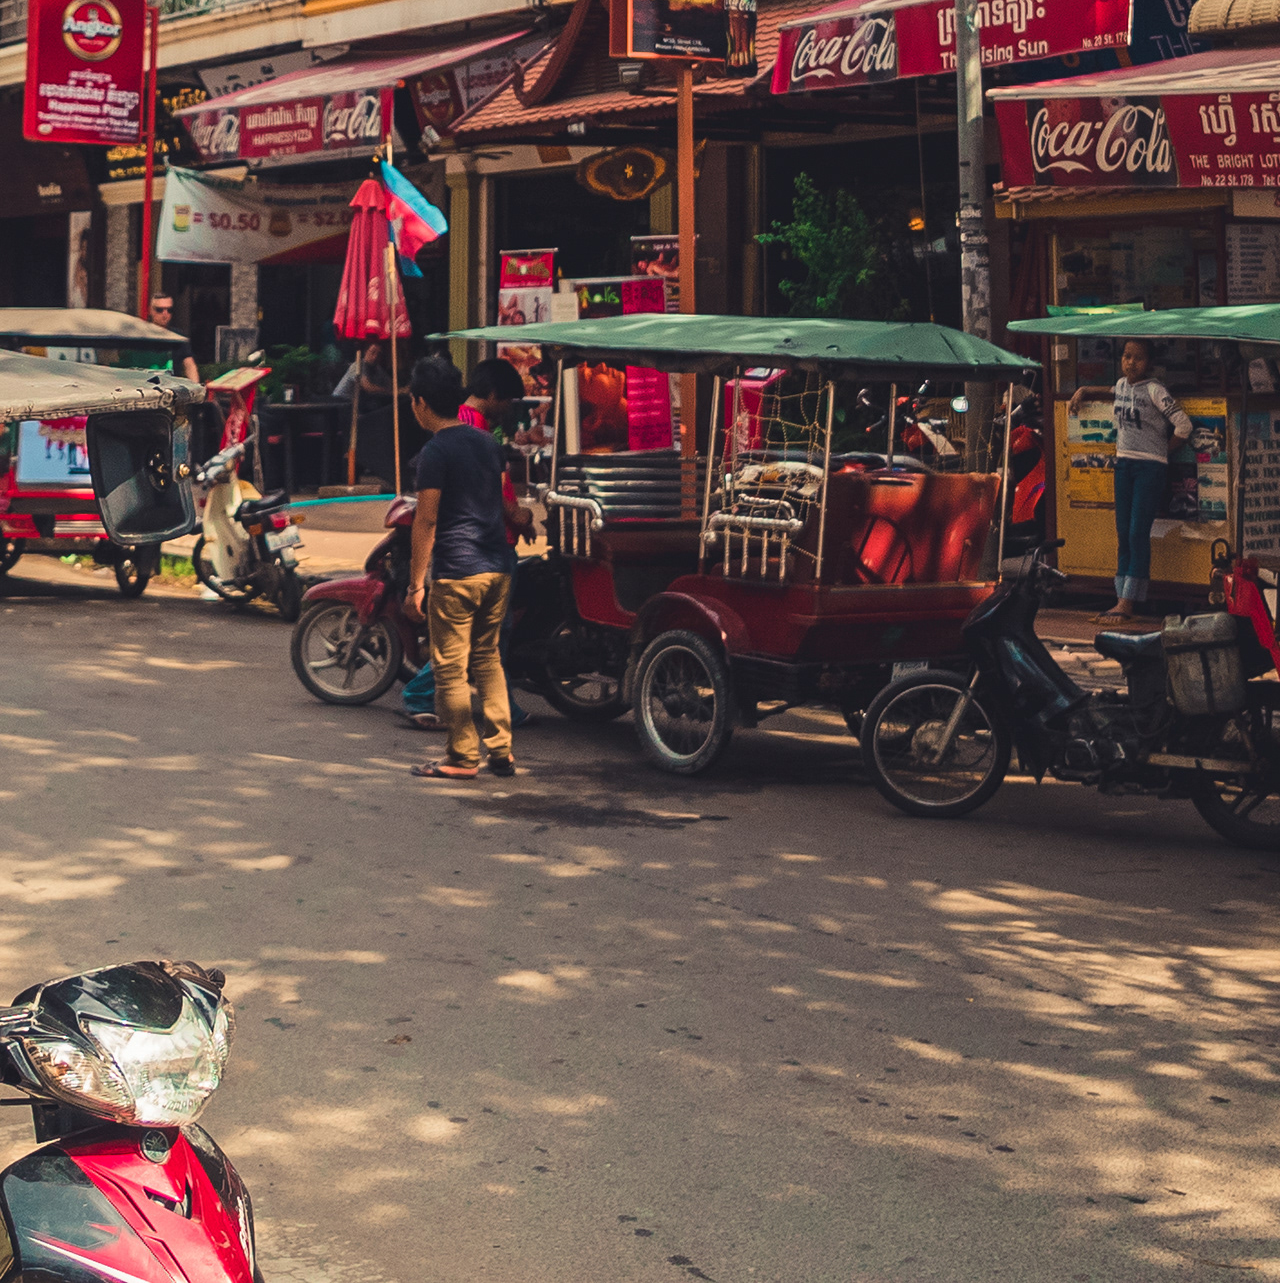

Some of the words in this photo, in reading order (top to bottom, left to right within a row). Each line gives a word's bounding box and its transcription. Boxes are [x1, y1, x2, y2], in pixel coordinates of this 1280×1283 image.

[63, 16, 122, 39] Angkor
[791, 18, 895, 82] Coca-Cola
[980, 45, 1014, 63] ising
[1018, 39, 1048, 56] Sun
[323, 95, 381, 144] Coca-Cola
[1031, 104, 1172, 173] Coca-Cola
[1189, 154, 1210, 169] THE
[1217, 154, 1254, 169] BRIGHT
[1200, 175, 1213, 186] No.
[1215, 175, 1225, 186] 22
[1227, 174, 1239, 186] St.
[1240, 174, 1254, 186] 178
[209, 212, 260, 231] $0.50
